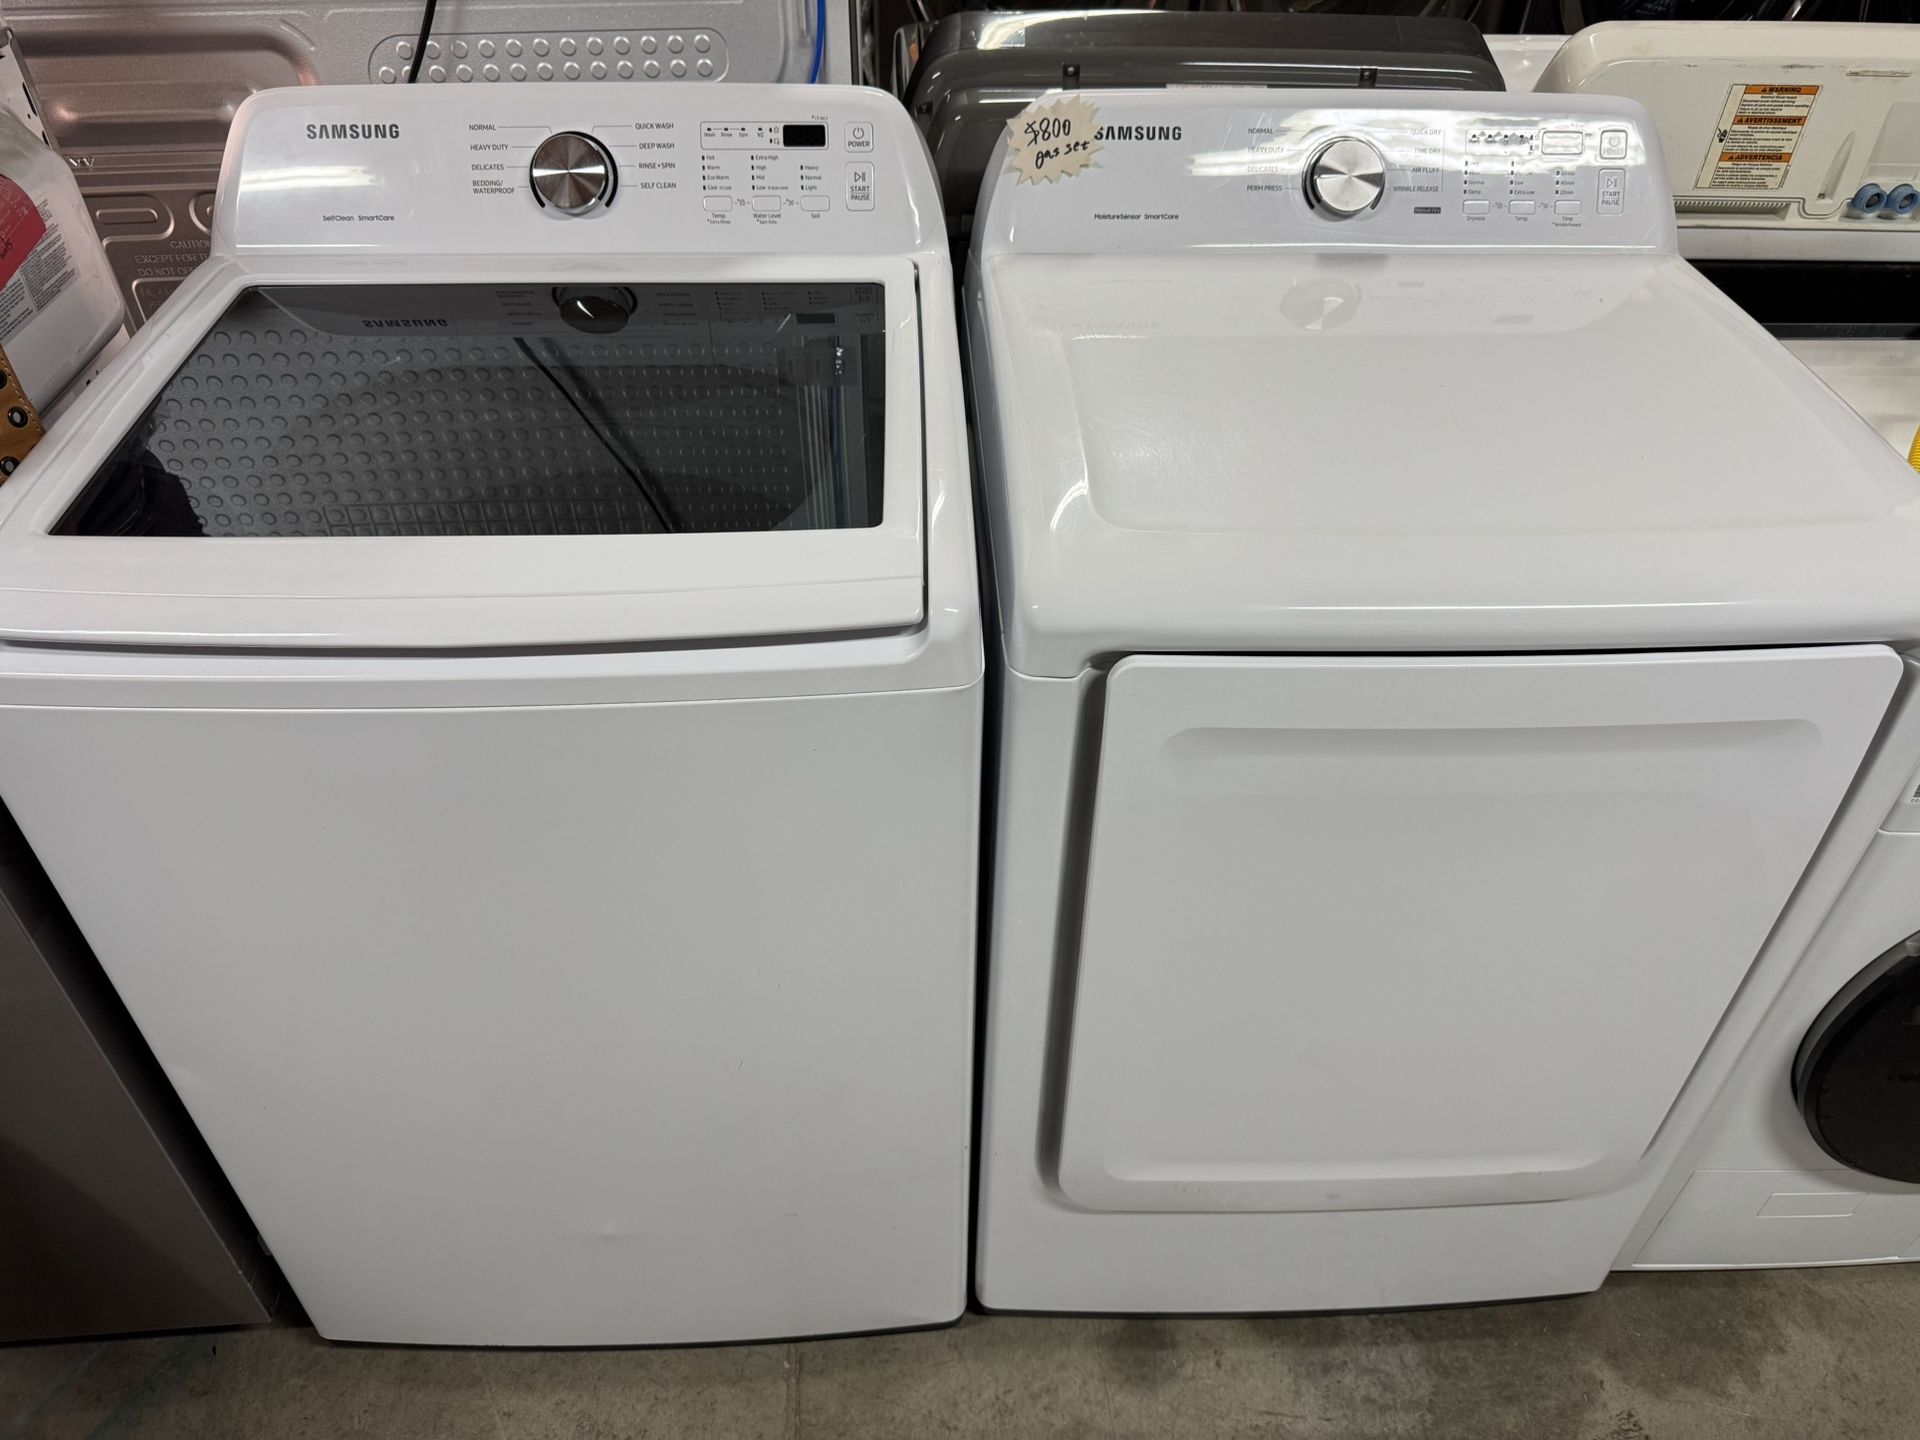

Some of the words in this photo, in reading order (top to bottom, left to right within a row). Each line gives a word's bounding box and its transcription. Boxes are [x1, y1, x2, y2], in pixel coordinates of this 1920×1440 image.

[655, 122, 674, 130] WASH
[306, 123, 400, 140] SAMSUNG
[739, 132, 748, 140] Spin
[1024, 118, 1072, 147] $800
[1094, 126, 1182, 141] SAMSUNG
[1035, 147, 1060, 169] gas
[1064, 141, 1090, 155] set
[471, 163, 504, 171] DELICATES
[1247, 165, 1279, 173] DELICATES
[135, 254, 173, 264] EXCEPT
[175, 253, 197, 262] FOR
[137, 267, 154, 276] DO
[154, 267, 175, 276] NOT
